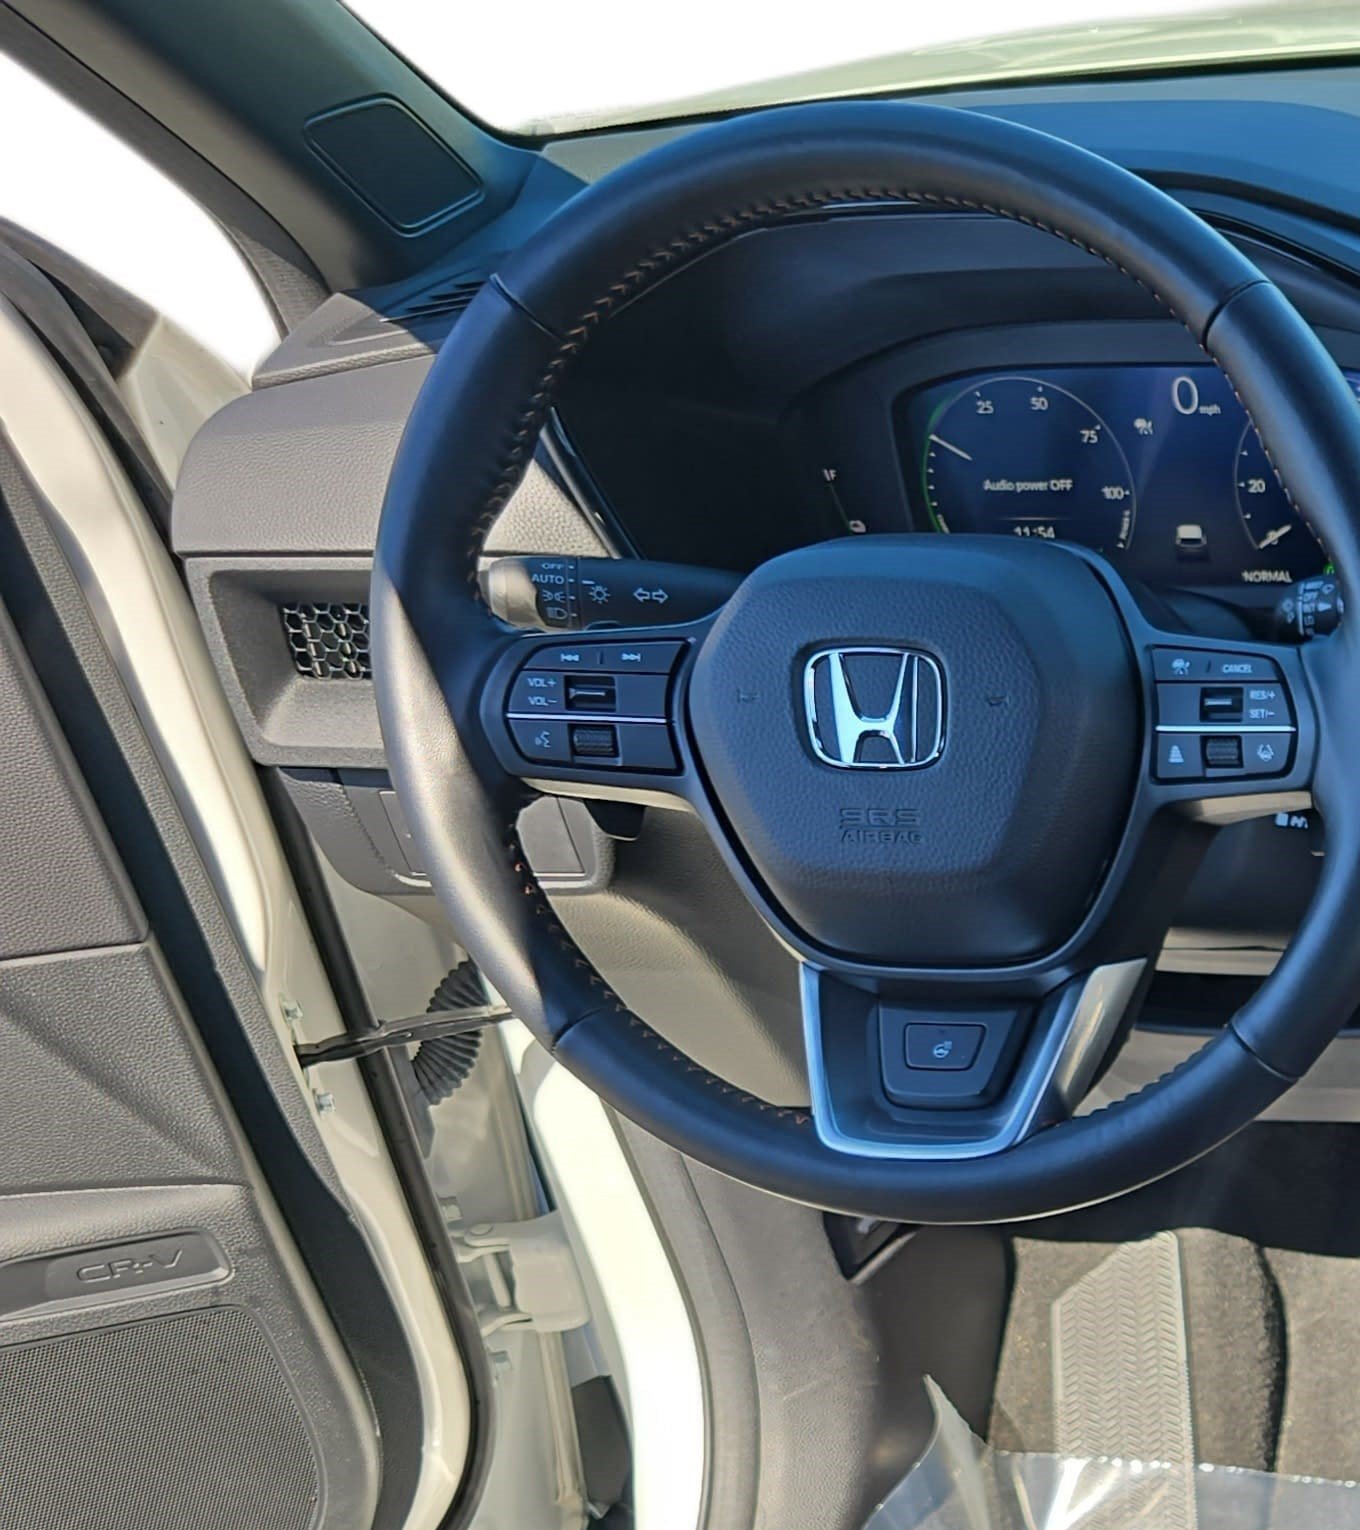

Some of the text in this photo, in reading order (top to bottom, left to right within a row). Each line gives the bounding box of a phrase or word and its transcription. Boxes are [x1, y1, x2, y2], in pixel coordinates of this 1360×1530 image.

[1171, 375, 1222, 416] 0 mph
[976, 401, 994, 414] 25
[1030, 397, 1048, 411] 50
[1080, 429, 1098, 443] 75
[983, 479, 1073, 493] Audio power OFF
[1102, 486, 1124, 500] 100
[1248, 480, 1265, 493] 20
[531, 574, 565, 584] AUTO
[1241, 571, 1293, 584] NORMAL
[1222, 663, 1253, 674] CANCEL
[76, 1249, 182, 1284] CR-V
